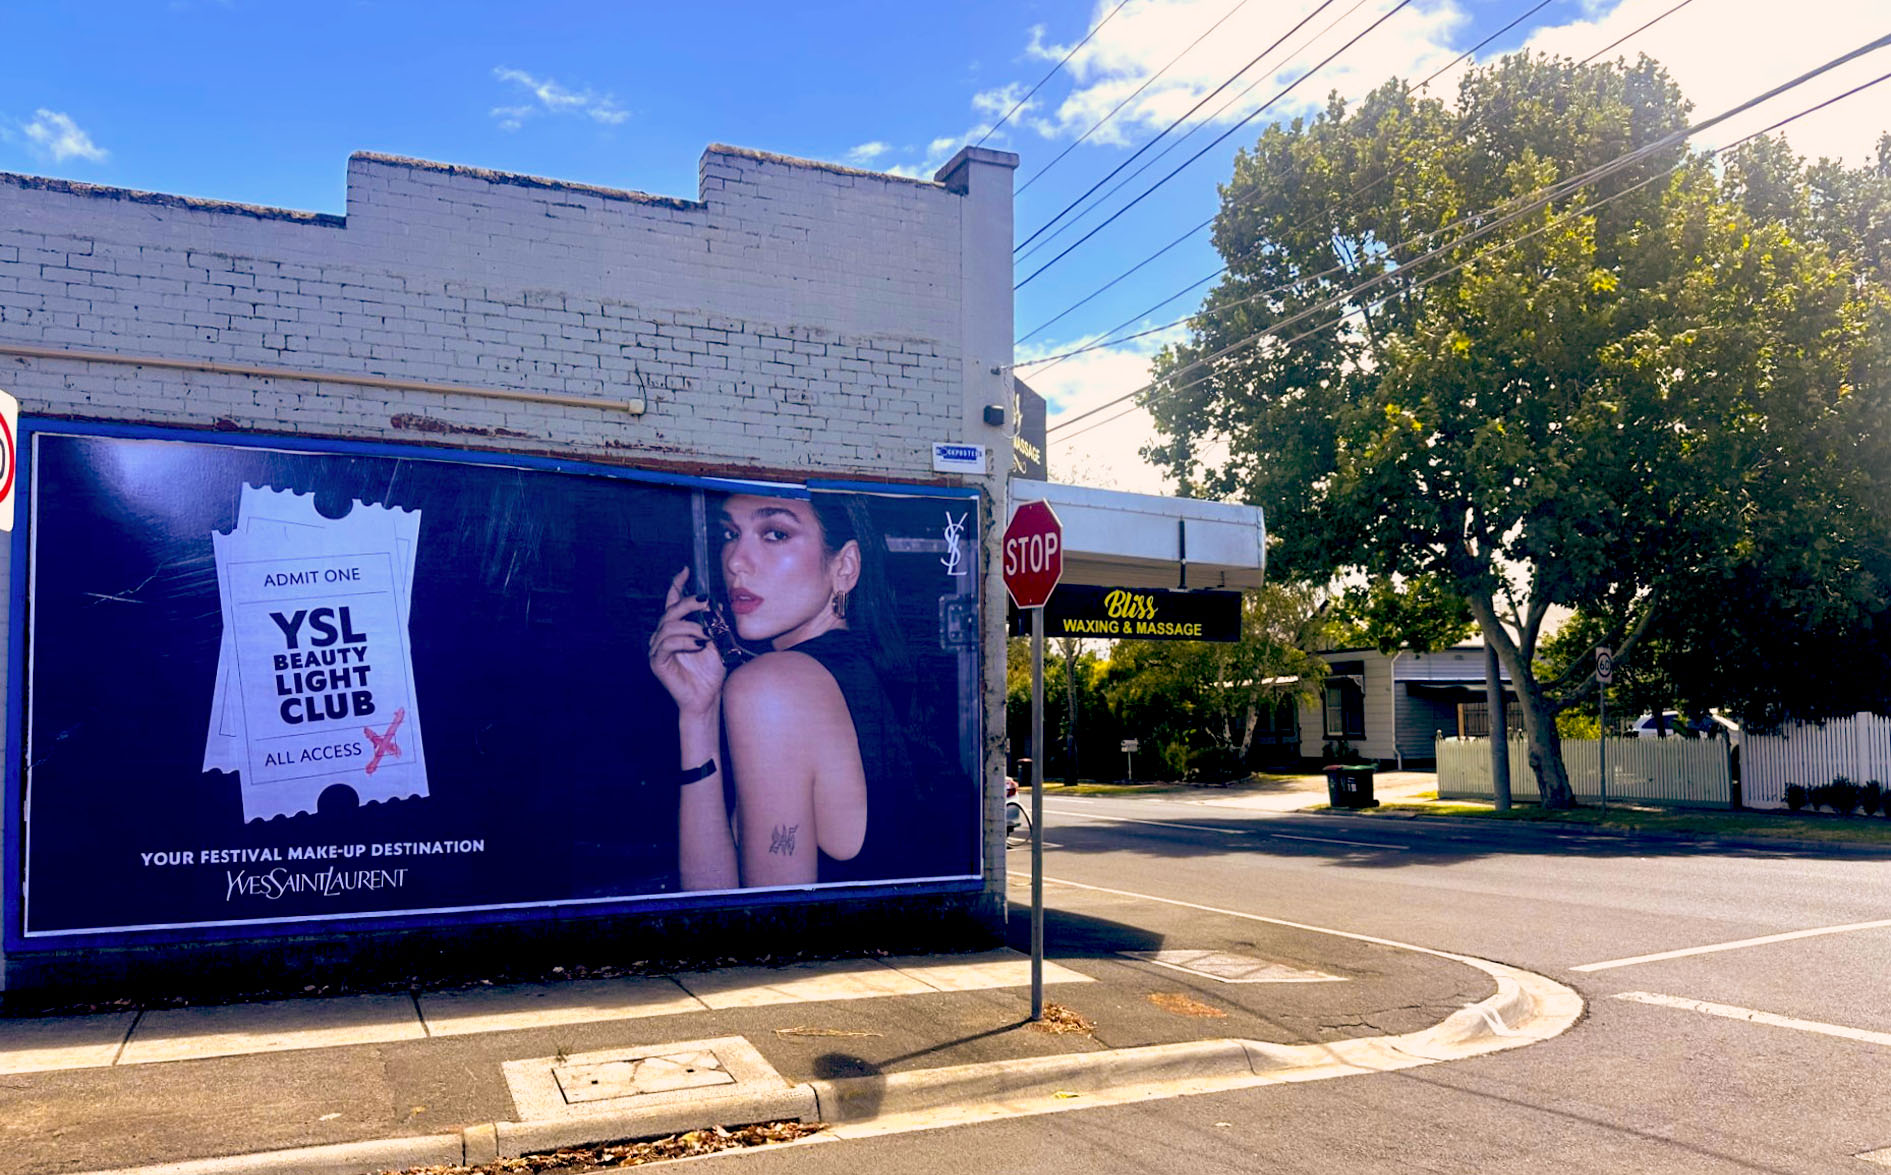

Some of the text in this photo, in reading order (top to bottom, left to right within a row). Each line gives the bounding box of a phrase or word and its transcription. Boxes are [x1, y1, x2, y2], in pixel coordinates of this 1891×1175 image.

[940, 511, 968, 576] YSL
[1006, 532, 1058, 576] STOP
[264, 568, 361, 587] ADMIT ONE
[1104, 589, 1159, 620] Bliss
[269, 606, 367, 650] YSL
[1063, 619, 1202, 636] WAXING & MASSAGE
[273, 646, 368, 671] BEAUTY
[276, 665, 371, 696] LIGHT
[280, 690, 376, 725] CLUB
[264, 742, 362, 767] ALL ACCESS
[141, 839, 485, 866] YOUR FESTIVAL MAKE-UP DESTINATION
